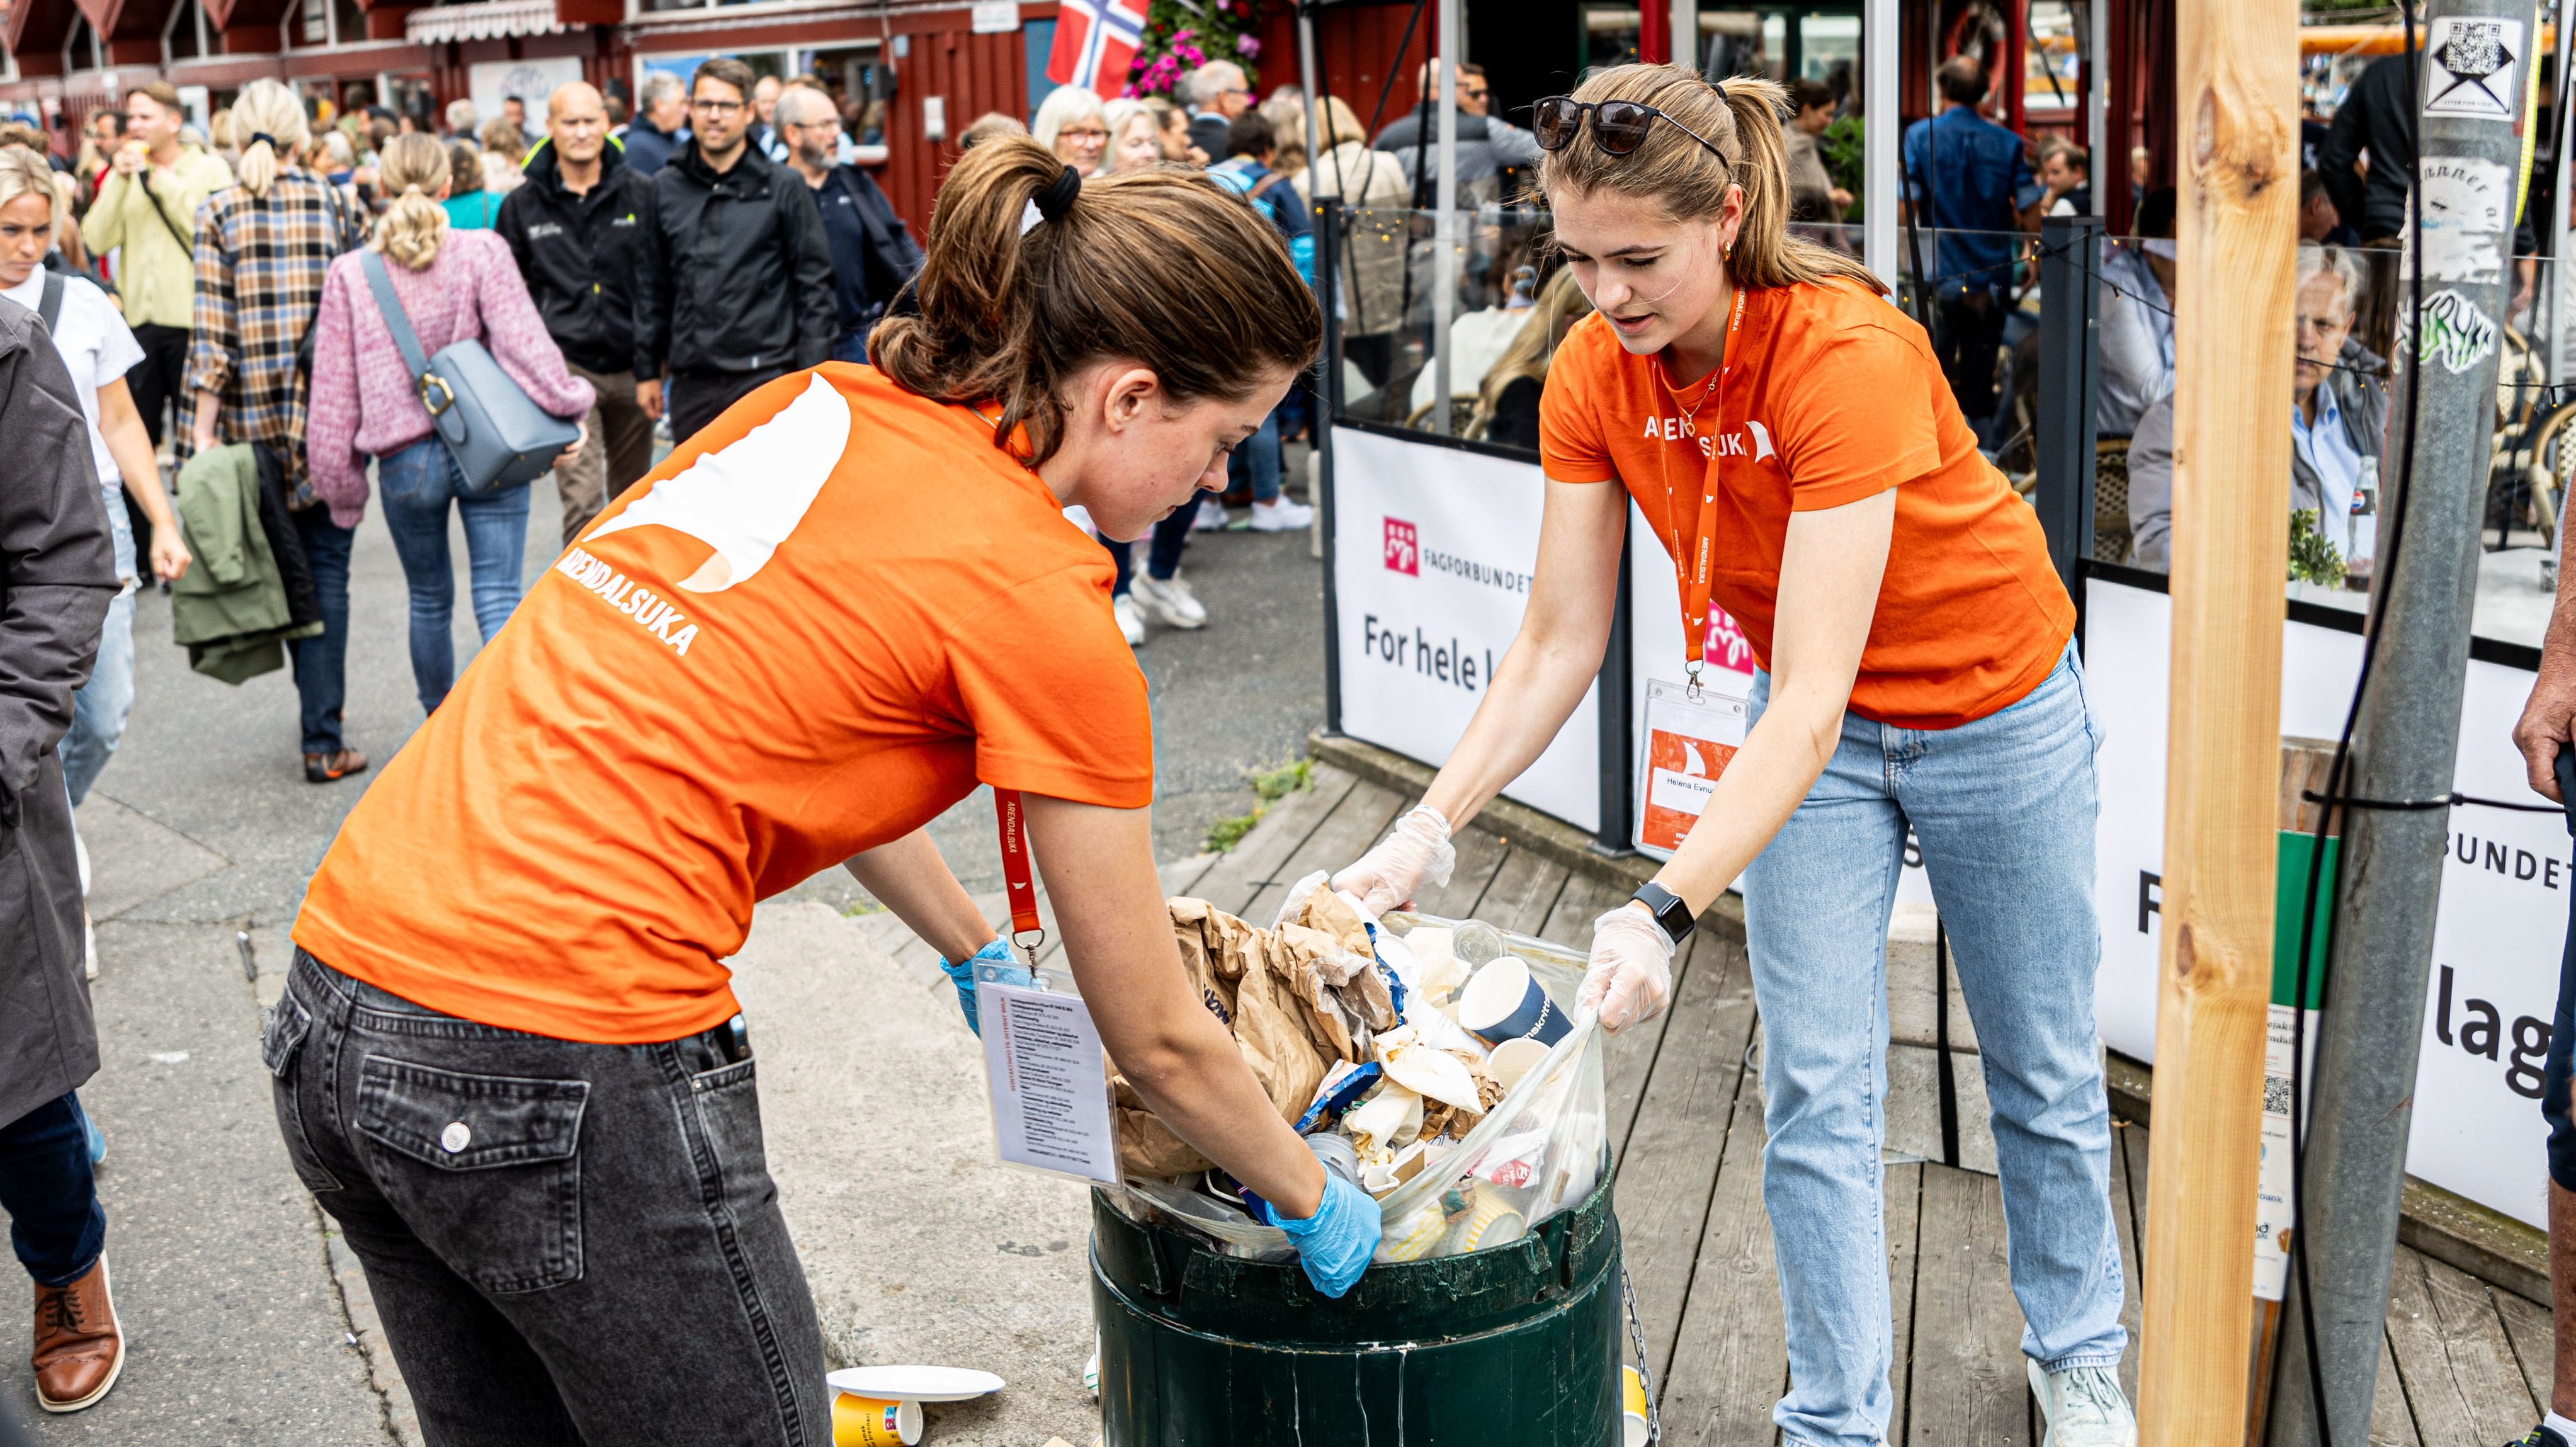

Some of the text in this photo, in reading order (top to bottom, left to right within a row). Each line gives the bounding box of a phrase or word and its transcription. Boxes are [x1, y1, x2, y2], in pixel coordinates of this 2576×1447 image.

[1732, 285, 1745, 332] RENDALSUKA
[1424, 547, 1533, 594] FAGFORBUNDET
[1698, 535, 1709, 584] ARENDALSUKA
[554, 546, 700, 657] ARENDALSUKA
[1365, 613, 1408, 666] For
[1416, 626, 1477, 691] hele
[1667, 776, 1714, 794] Helena Evnu
[1007, 800, 1018, 853] ARENDALSUKA
